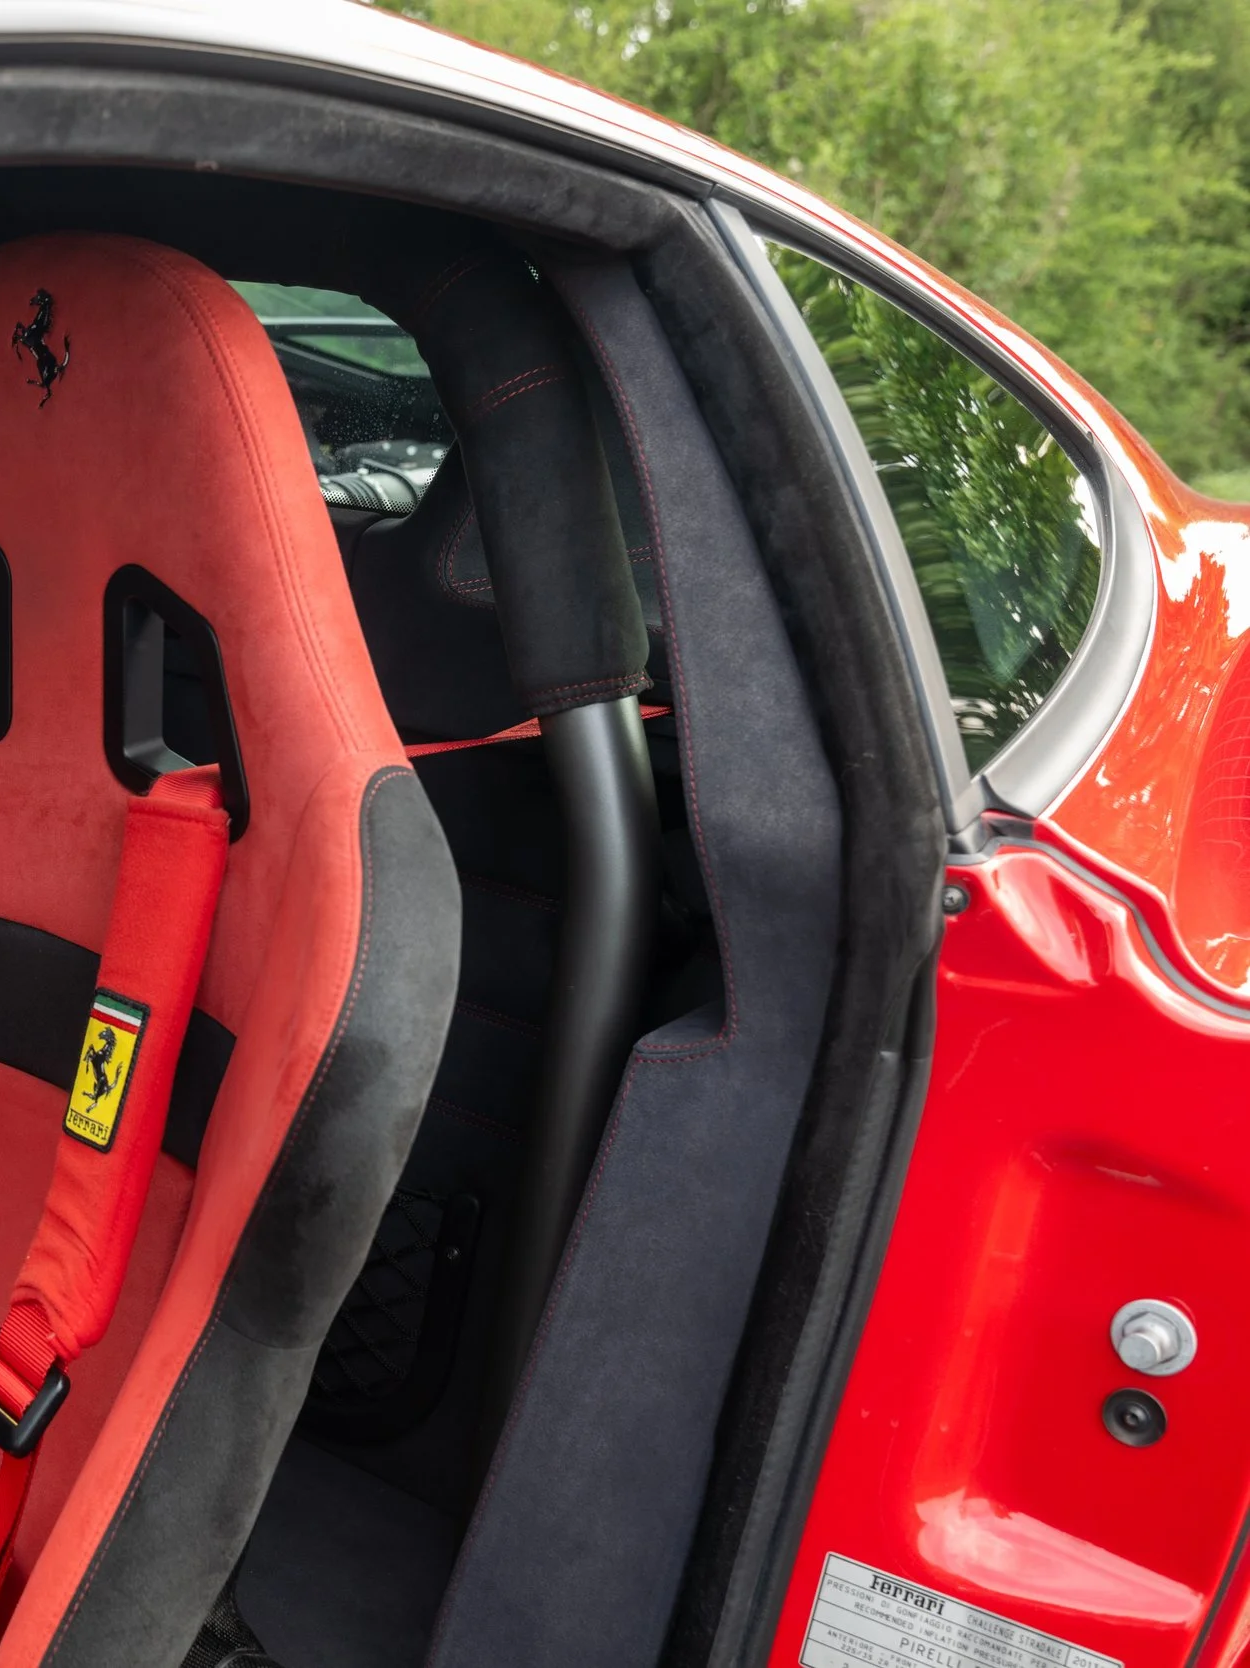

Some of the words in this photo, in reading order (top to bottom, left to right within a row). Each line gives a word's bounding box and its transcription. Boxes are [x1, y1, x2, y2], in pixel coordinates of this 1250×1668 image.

[67, 1109, 109, 1140] Ferrari
[827, 1579, 875, 1603] PRESSIONI
[896, 1606, 953, 1633] GONFIAGGIO
[958, 1630, 1023, 1661] RACCOMANDATE
[854, 1602, 914, 1630] RECOMMENDED
[919, 1624, 969, 1652] INFLATION
[869, 1574, 946, 1615] Ferrari
[966, 1614, 1014, 1641] CHALLENGE
[1019, 1634, 1063, 1659] STRADALE
[827, 1630, 875, 1652] ANTERIORE
[899, 1637, 961, 1668] PIRELLI
